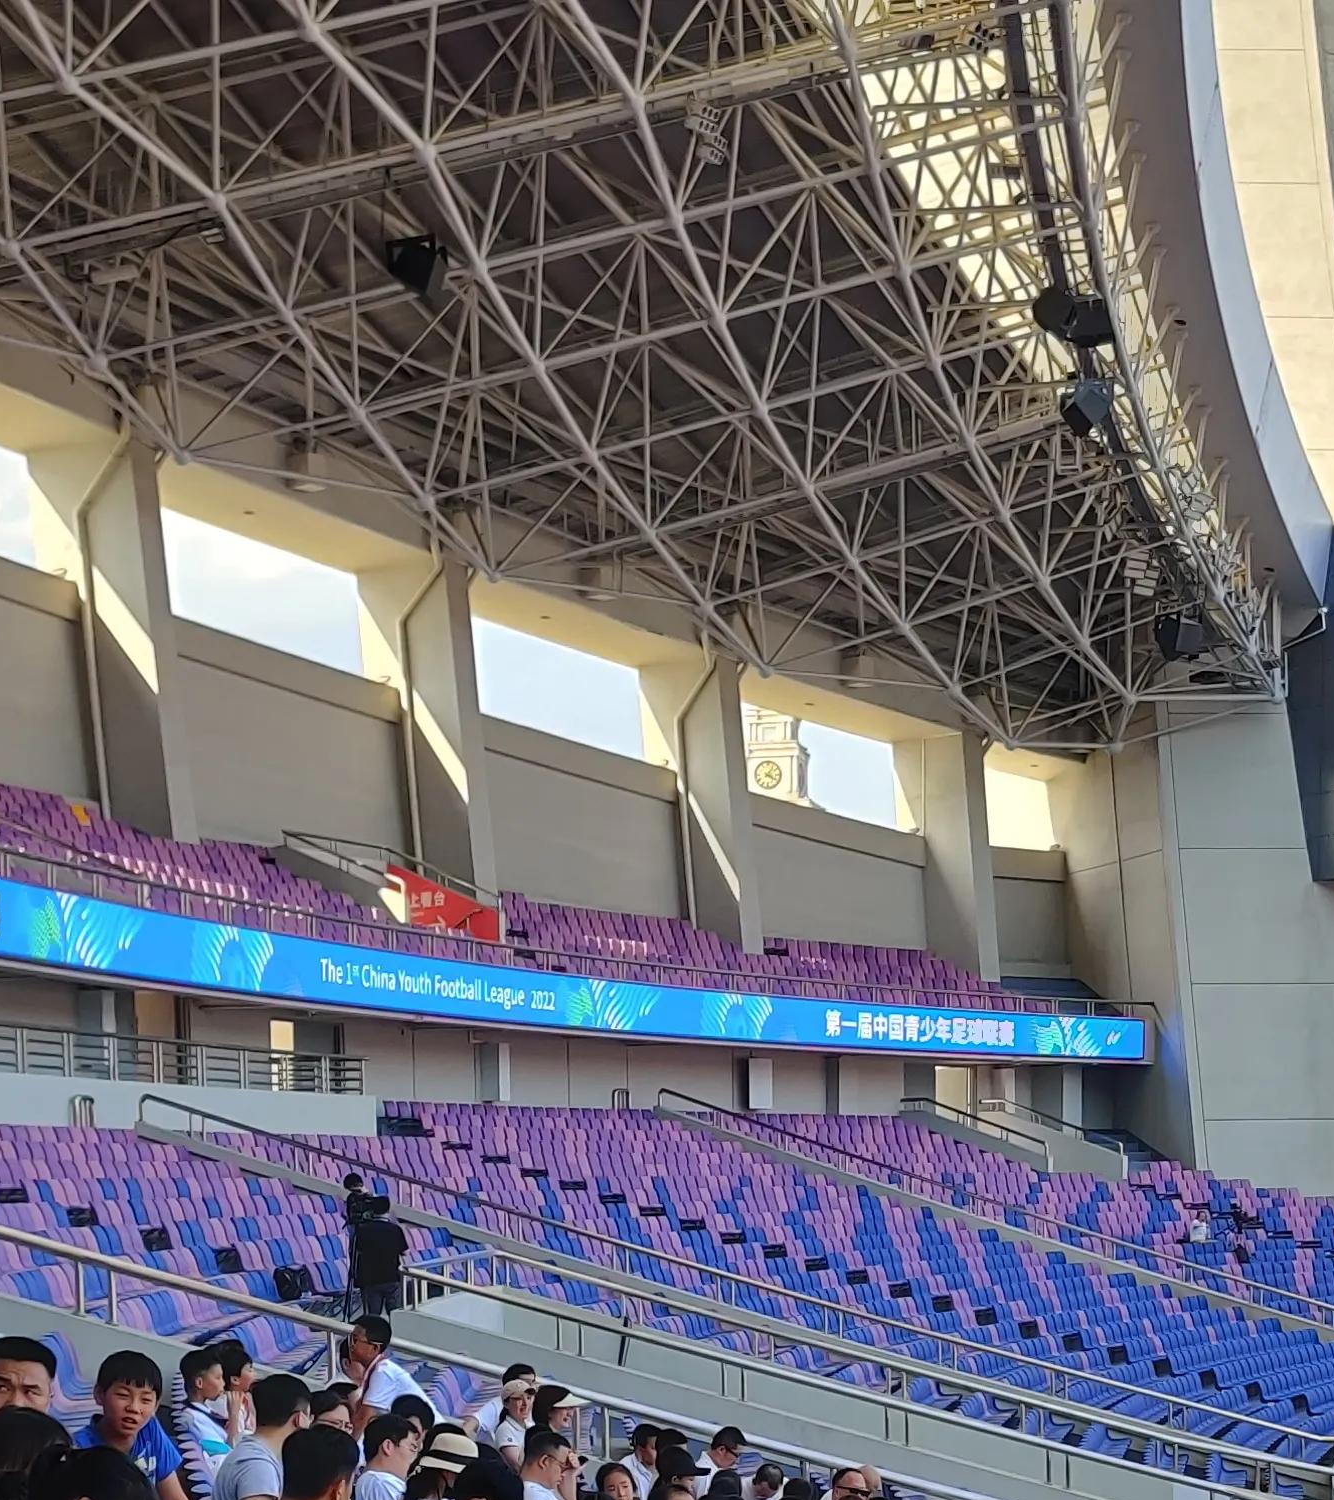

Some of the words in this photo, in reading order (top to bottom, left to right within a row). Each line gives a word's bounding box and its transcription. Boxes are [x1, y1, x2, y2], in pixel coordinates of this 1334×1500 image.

[320, 958, 343, 985] The
[361, 965, 396, 991] China
[398, 970, 432, 996] Youth
[434, 975, 482, 1001] Football
[484, 981, 525, 1010] League
[530, 990, 556, 1010] 2022
